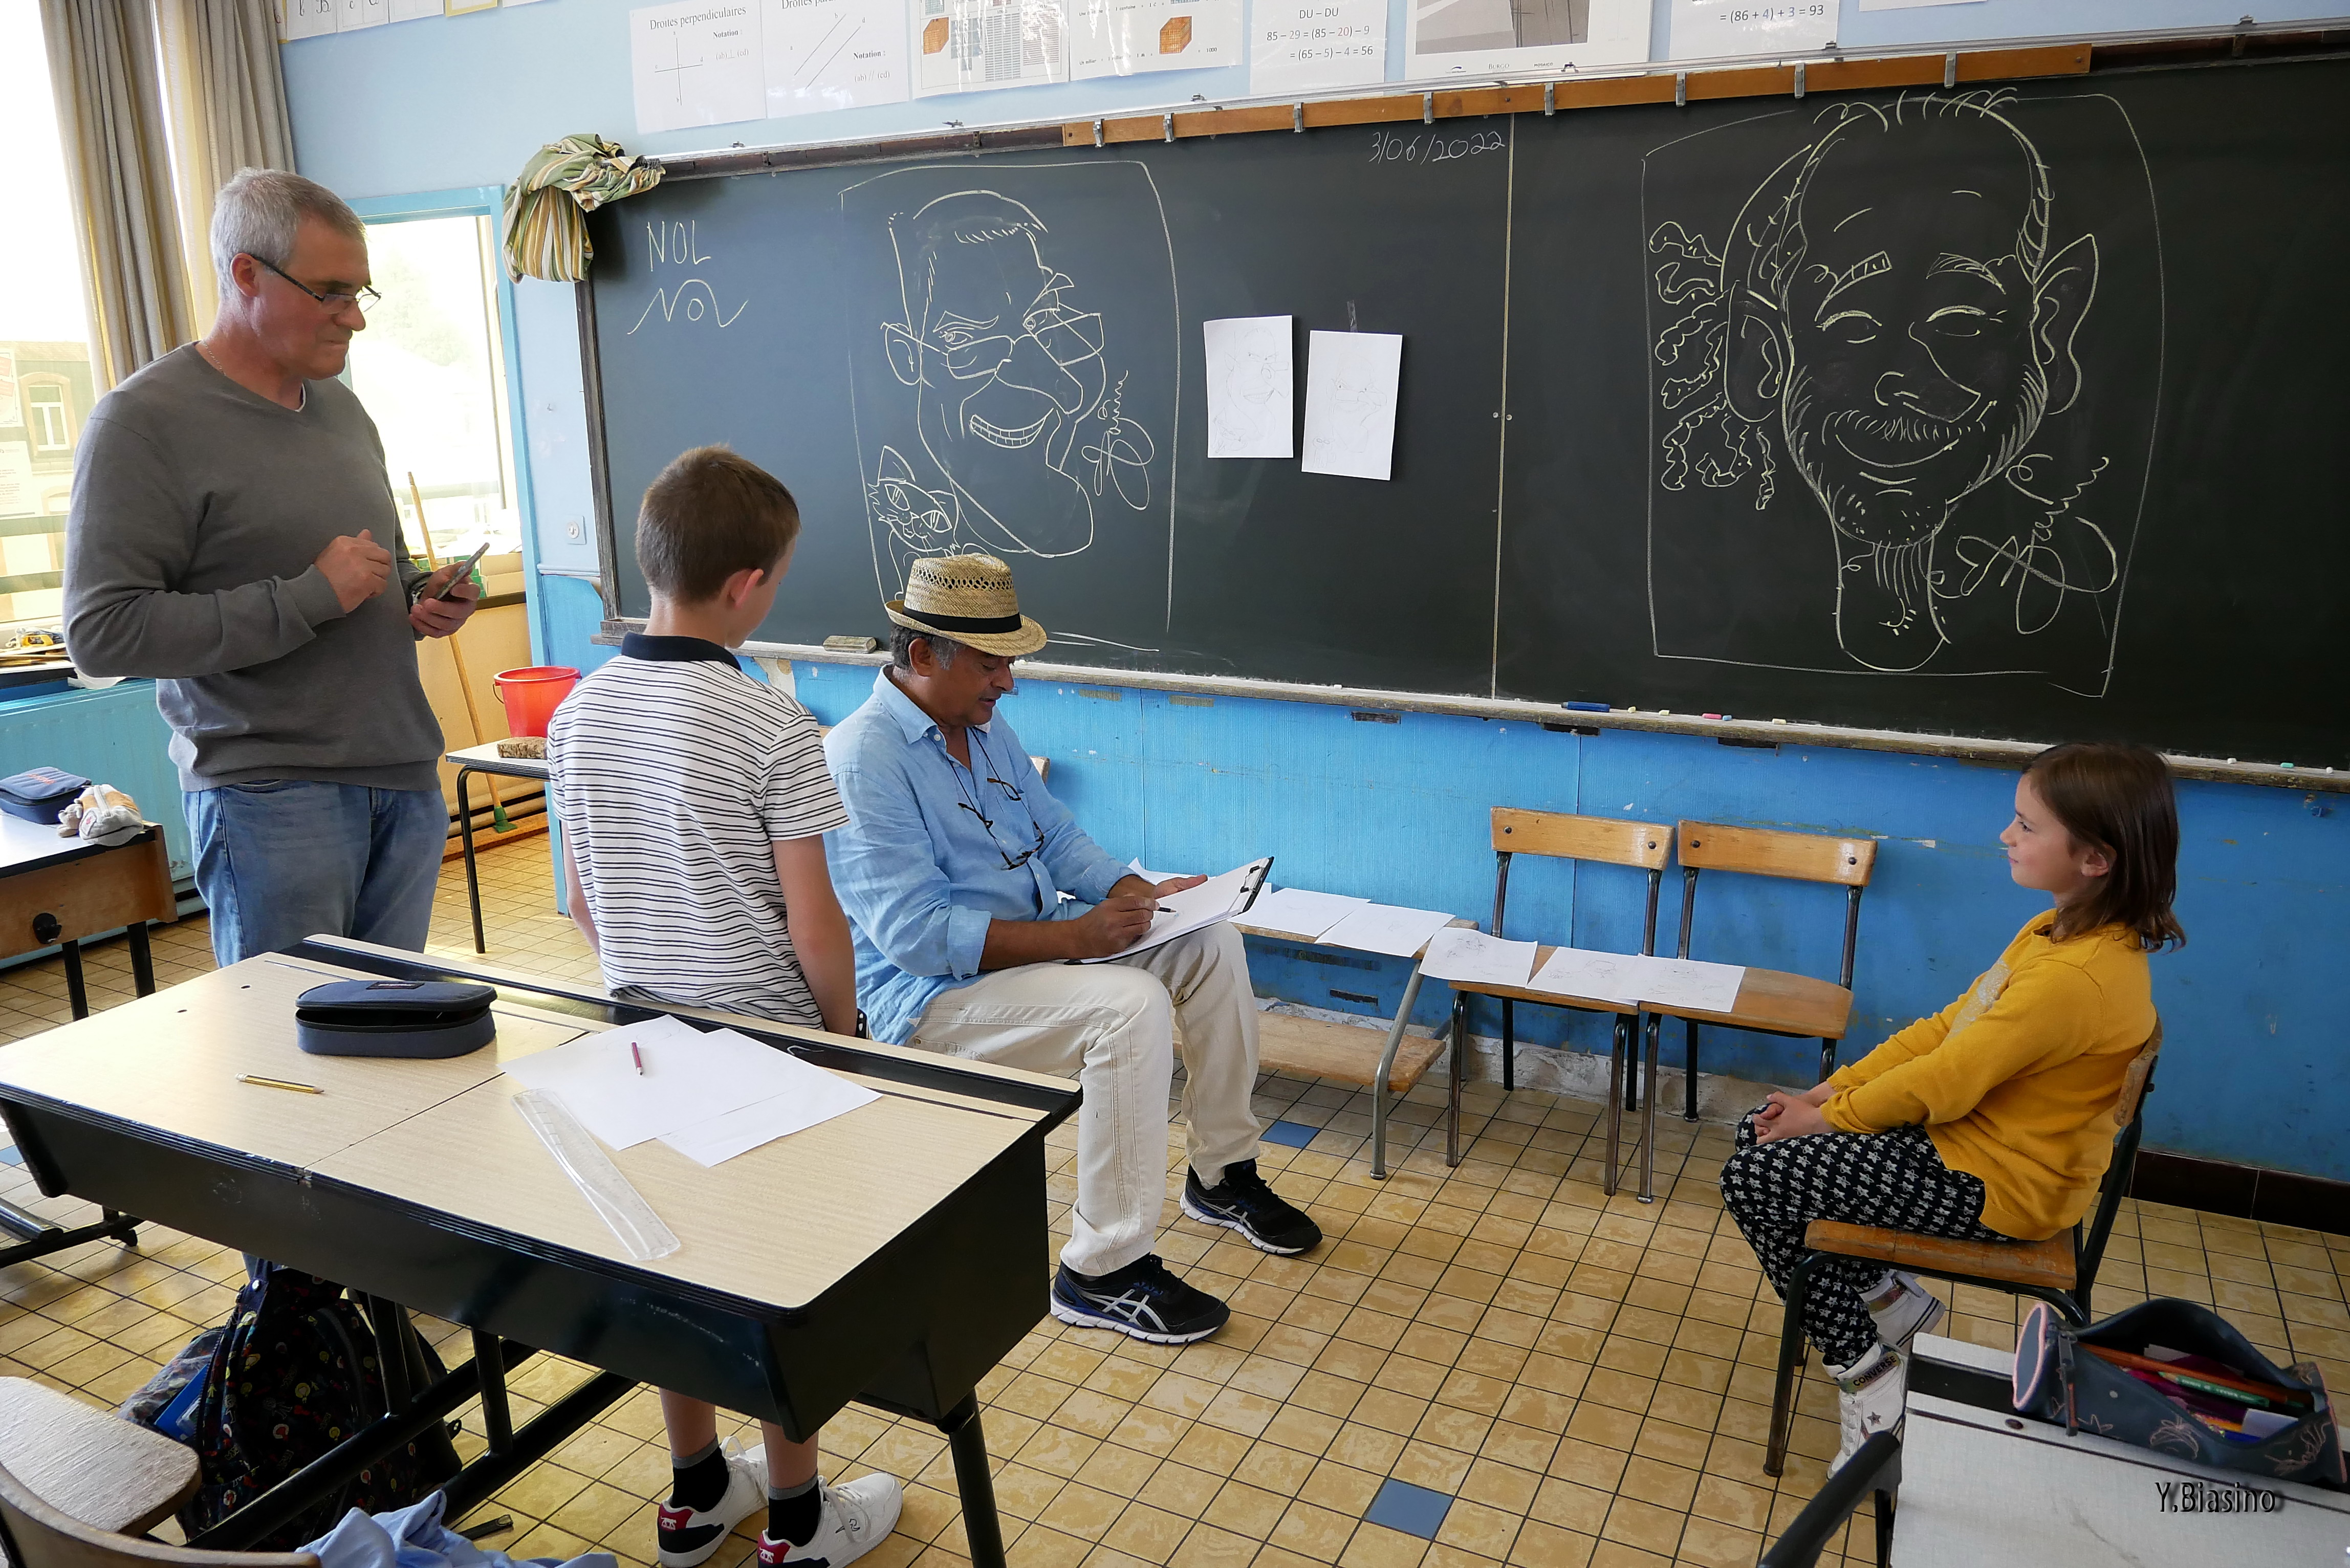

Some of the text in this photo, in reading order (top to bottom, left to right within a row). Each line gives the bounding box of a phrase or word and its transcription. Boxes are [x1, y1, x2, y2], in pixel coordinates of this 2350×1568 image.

[1299, 9, 1313, 18] DU
[1324, 7, 1339, 17] DU
[1810, 4, 1823, 16] 93
[650, 6, 747, 30] Droites perpendiculaires
[713, 29, 738, 39] Notation
[853, 50, 881, 60] Notation
[1361, 46, 1373, 55] 56
[647, 220, 712, 272] NOL
[1853, 1356, 1897, 1386] CONVERSE
